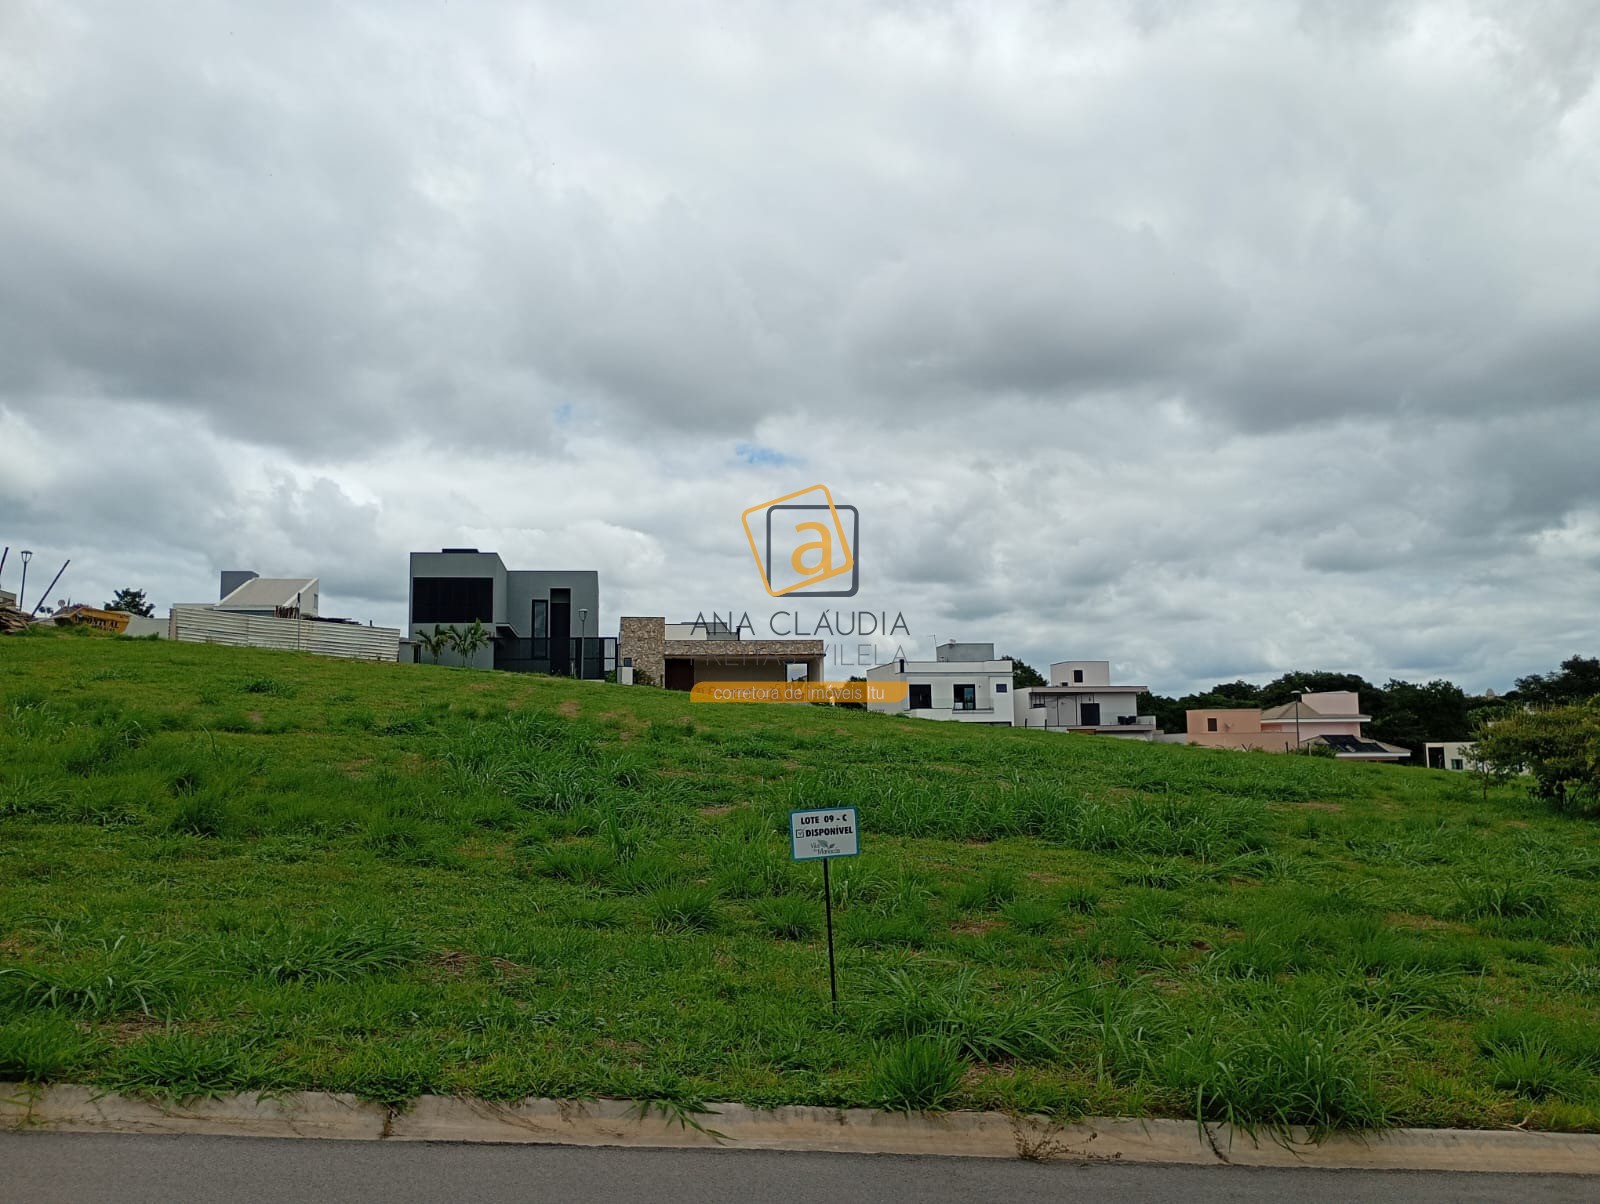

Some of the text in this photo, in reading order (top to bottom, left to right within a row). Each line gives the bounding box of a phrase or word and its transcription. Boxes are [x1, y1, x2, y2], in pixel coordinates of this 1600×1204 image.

[801, 816, 820, 824] LOTE
[824, 815, 834, 823] 09
[842, 814, 847, 822] C
[806, 825, 853, 837] DISPONÍVEL
